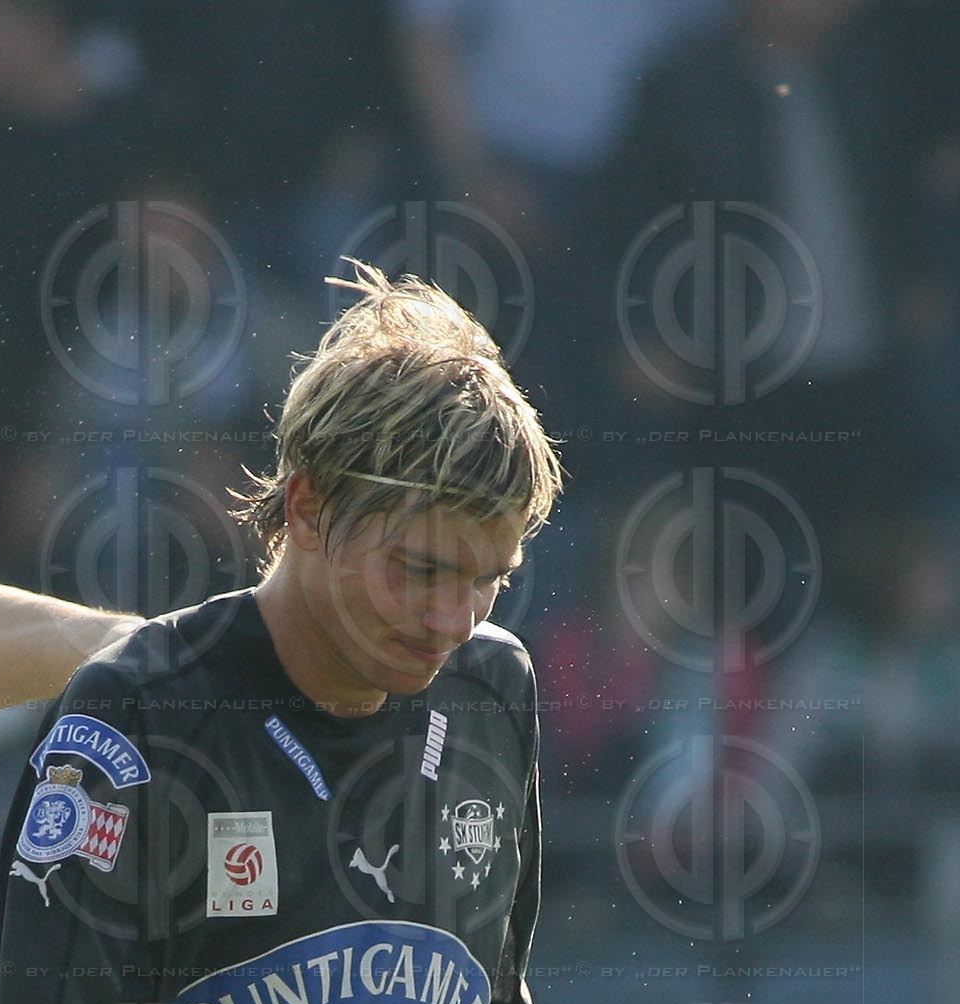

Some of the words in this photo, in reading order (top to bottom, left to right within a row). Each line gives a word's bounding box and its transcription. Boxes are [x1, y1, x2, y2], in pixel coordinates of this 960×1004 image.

[40, 724, 140, 783] TIGAMER
[420, 710, 448, 781] PUMA
[212, 899, 273, 911] LIGA
